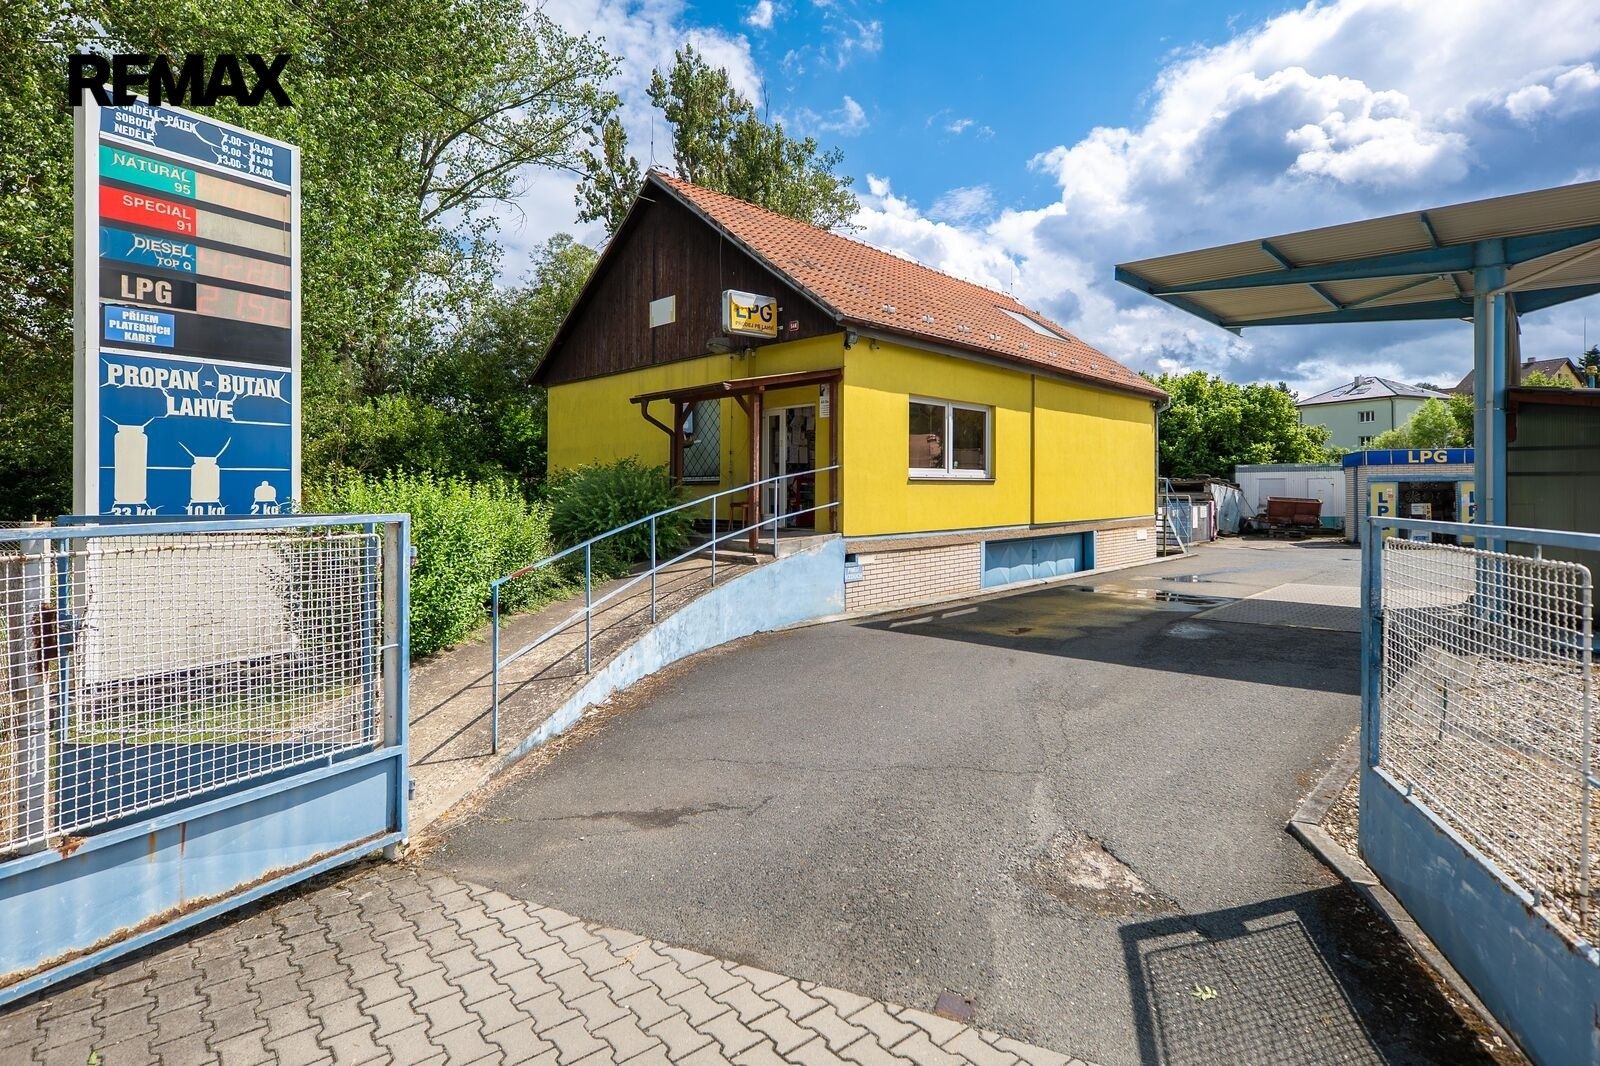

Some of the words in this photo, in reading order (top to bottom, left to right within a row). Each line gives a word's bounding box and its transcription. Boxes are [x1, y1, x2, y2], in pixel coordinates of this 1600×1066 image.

[115, 111, 156, 131] SOBOTA
[113, 153, 191, 182] NATURAL
[174, 182, 191, 194] 95
[123, 195, 191, 220] SPECIAL
[177, 220, 192, 232] 91
[134, 236, 191, 258] DIESEL
[158, 257, 179, 268] TOP
[183, 262, 192, 271] Q
[121, 274, 172, 304] LPG
[122, 310, 158, 324] PŘÍJEM
[736, 304, 772, 322] LPG
[109, 319, 170, 335] PLATEBNÍCH
[124, 331, 156, 344] KARET
[108, 364, 199, 390] PROPAN
[218, 374, 280, 397] BUTAN
[167, 396, 233, 418] LAHVE
[1408, 450, 1448, 463] LPG
[187, 505, 204, 515] 10
[251, 504, 259, 515] 2
